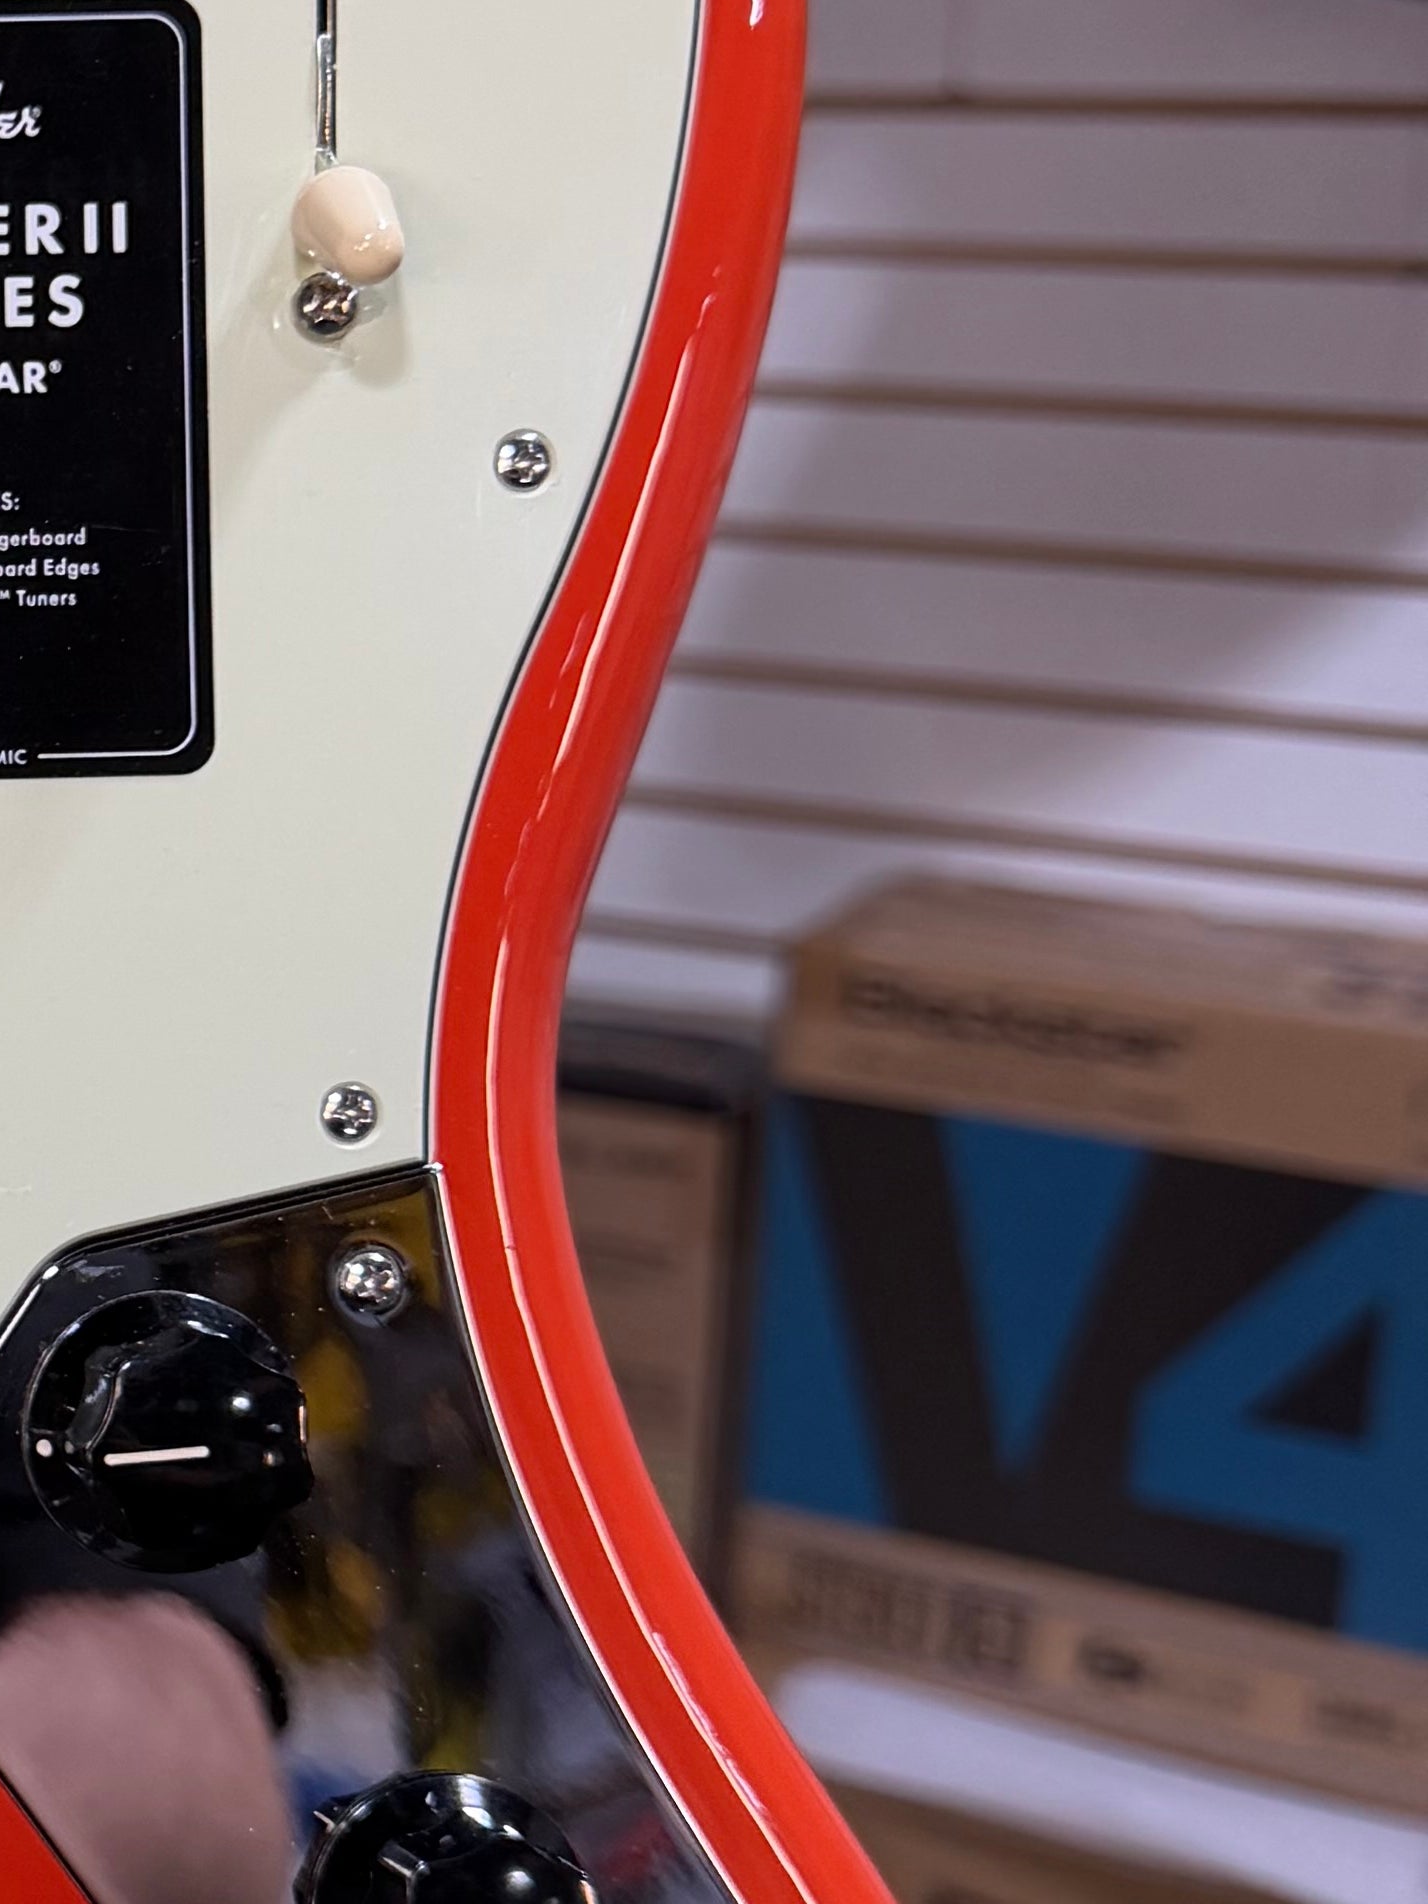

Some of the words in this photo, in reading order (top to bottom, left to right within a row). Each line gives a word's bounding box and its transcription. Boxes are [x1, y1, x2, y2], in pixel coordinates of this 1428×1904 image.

[83, 200, 128, 254] II
[43, 557, 100, 580] Edges
[16, 589, 77, 607] Tuners
